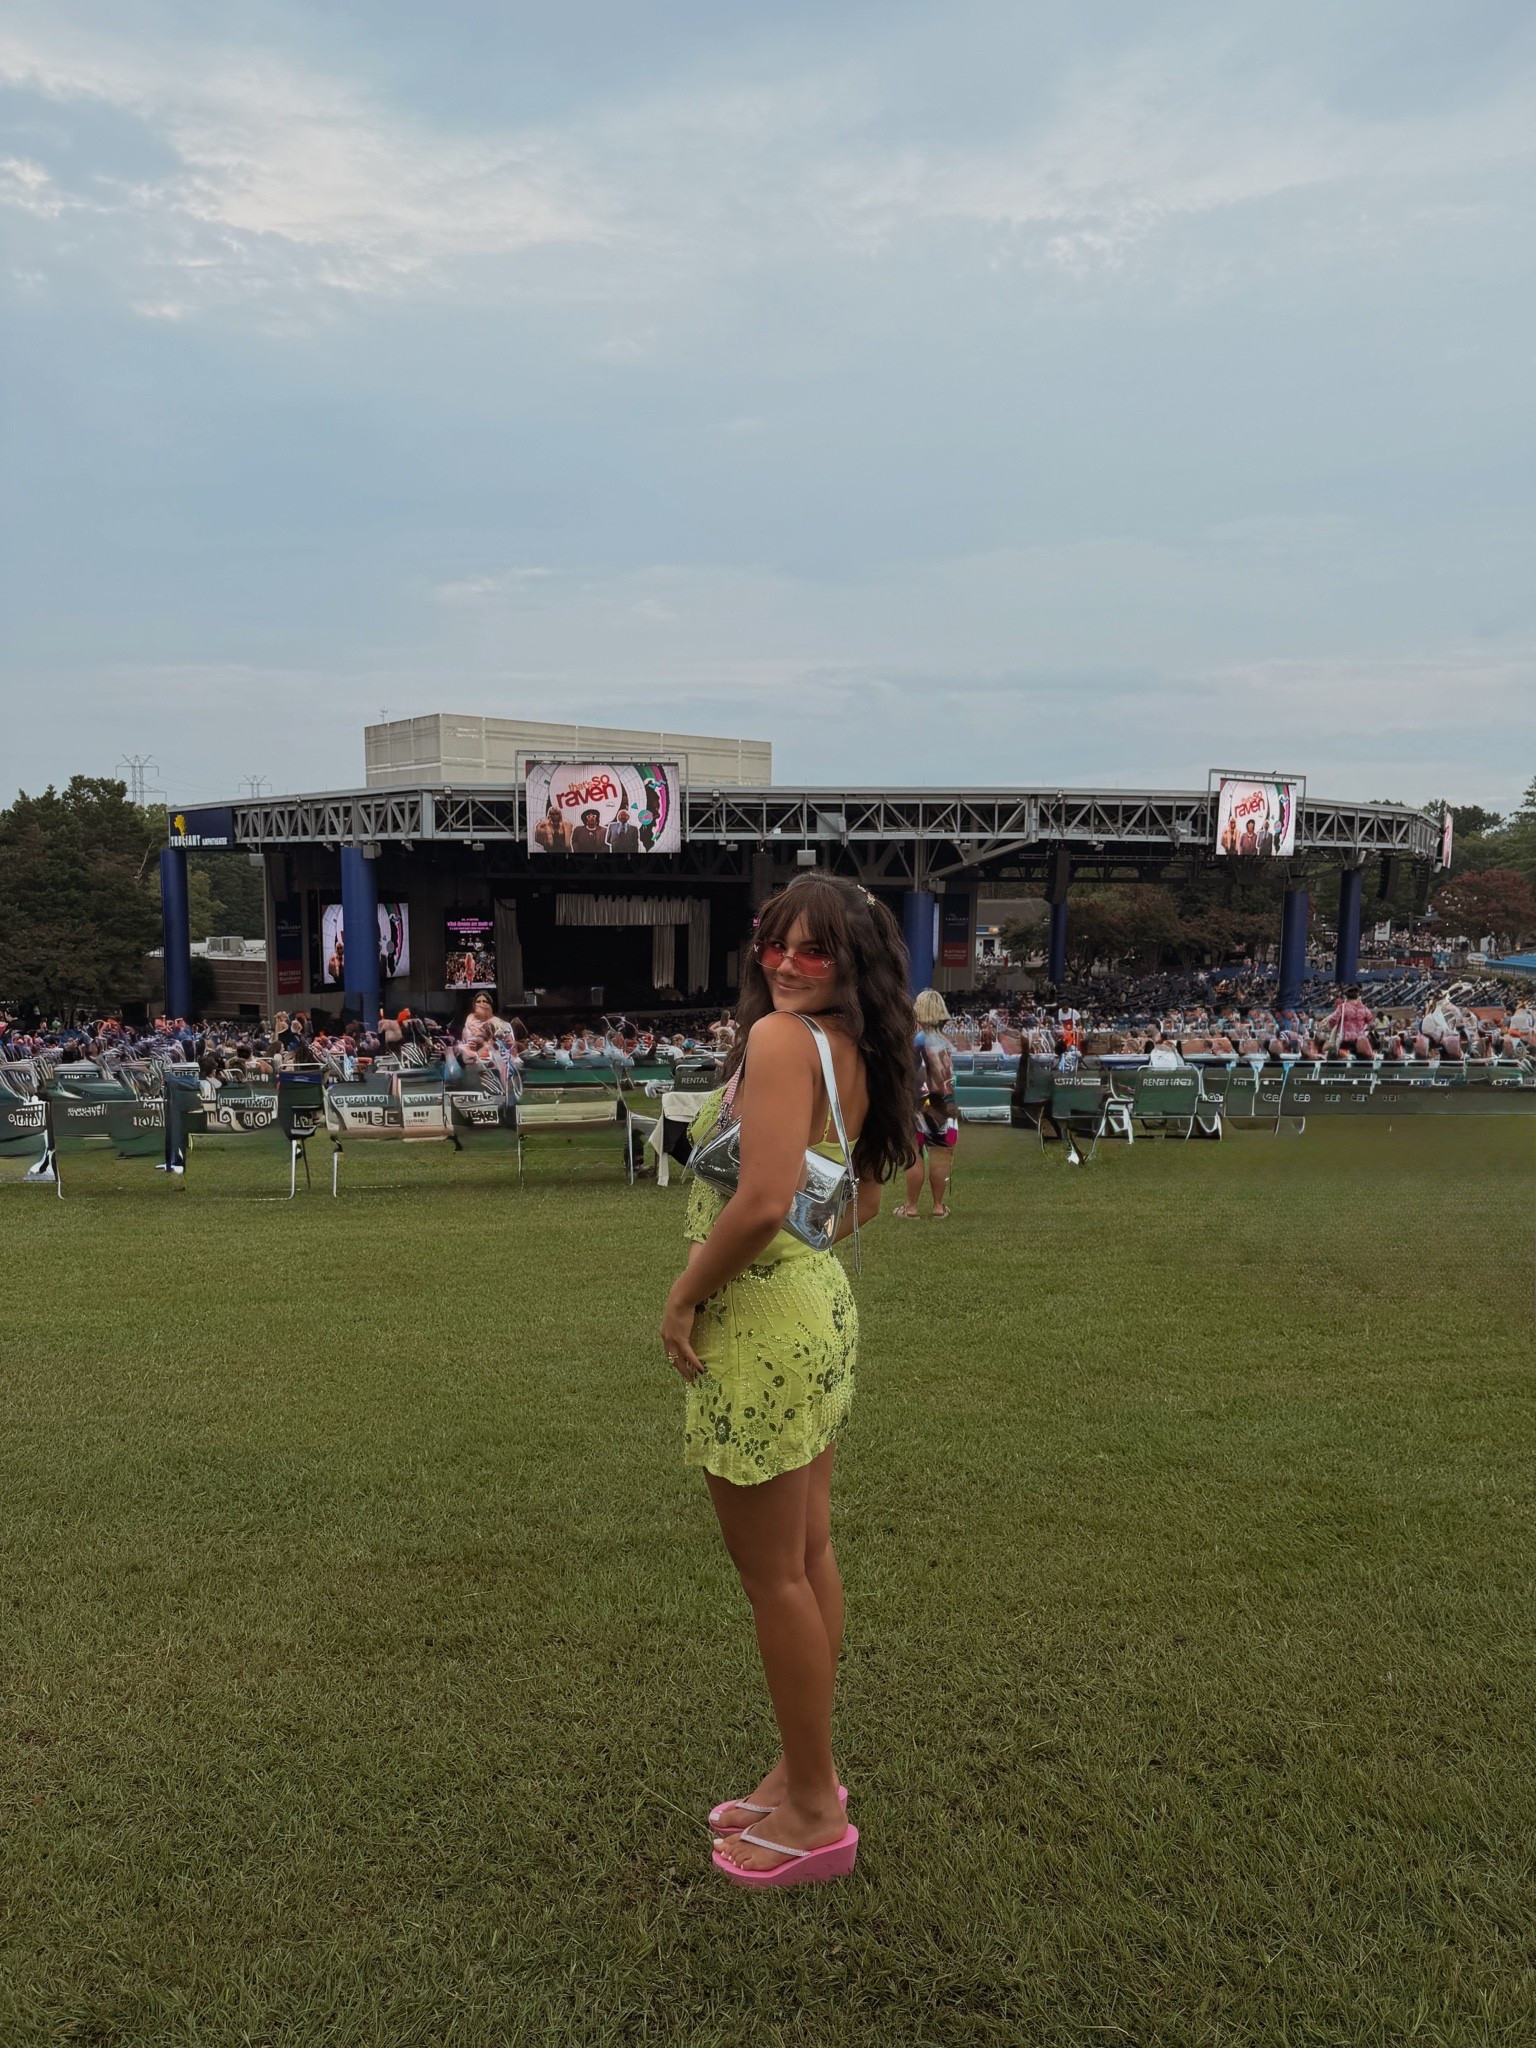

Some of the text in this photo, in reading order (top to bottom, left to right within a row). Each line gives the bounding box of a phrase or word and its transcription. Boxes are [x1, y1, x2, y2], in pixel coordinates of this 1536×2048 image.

[592, 774, 610, 786] so
[556, 783, 618, 809] raven
[1234, 798, 1265, 818] raven
